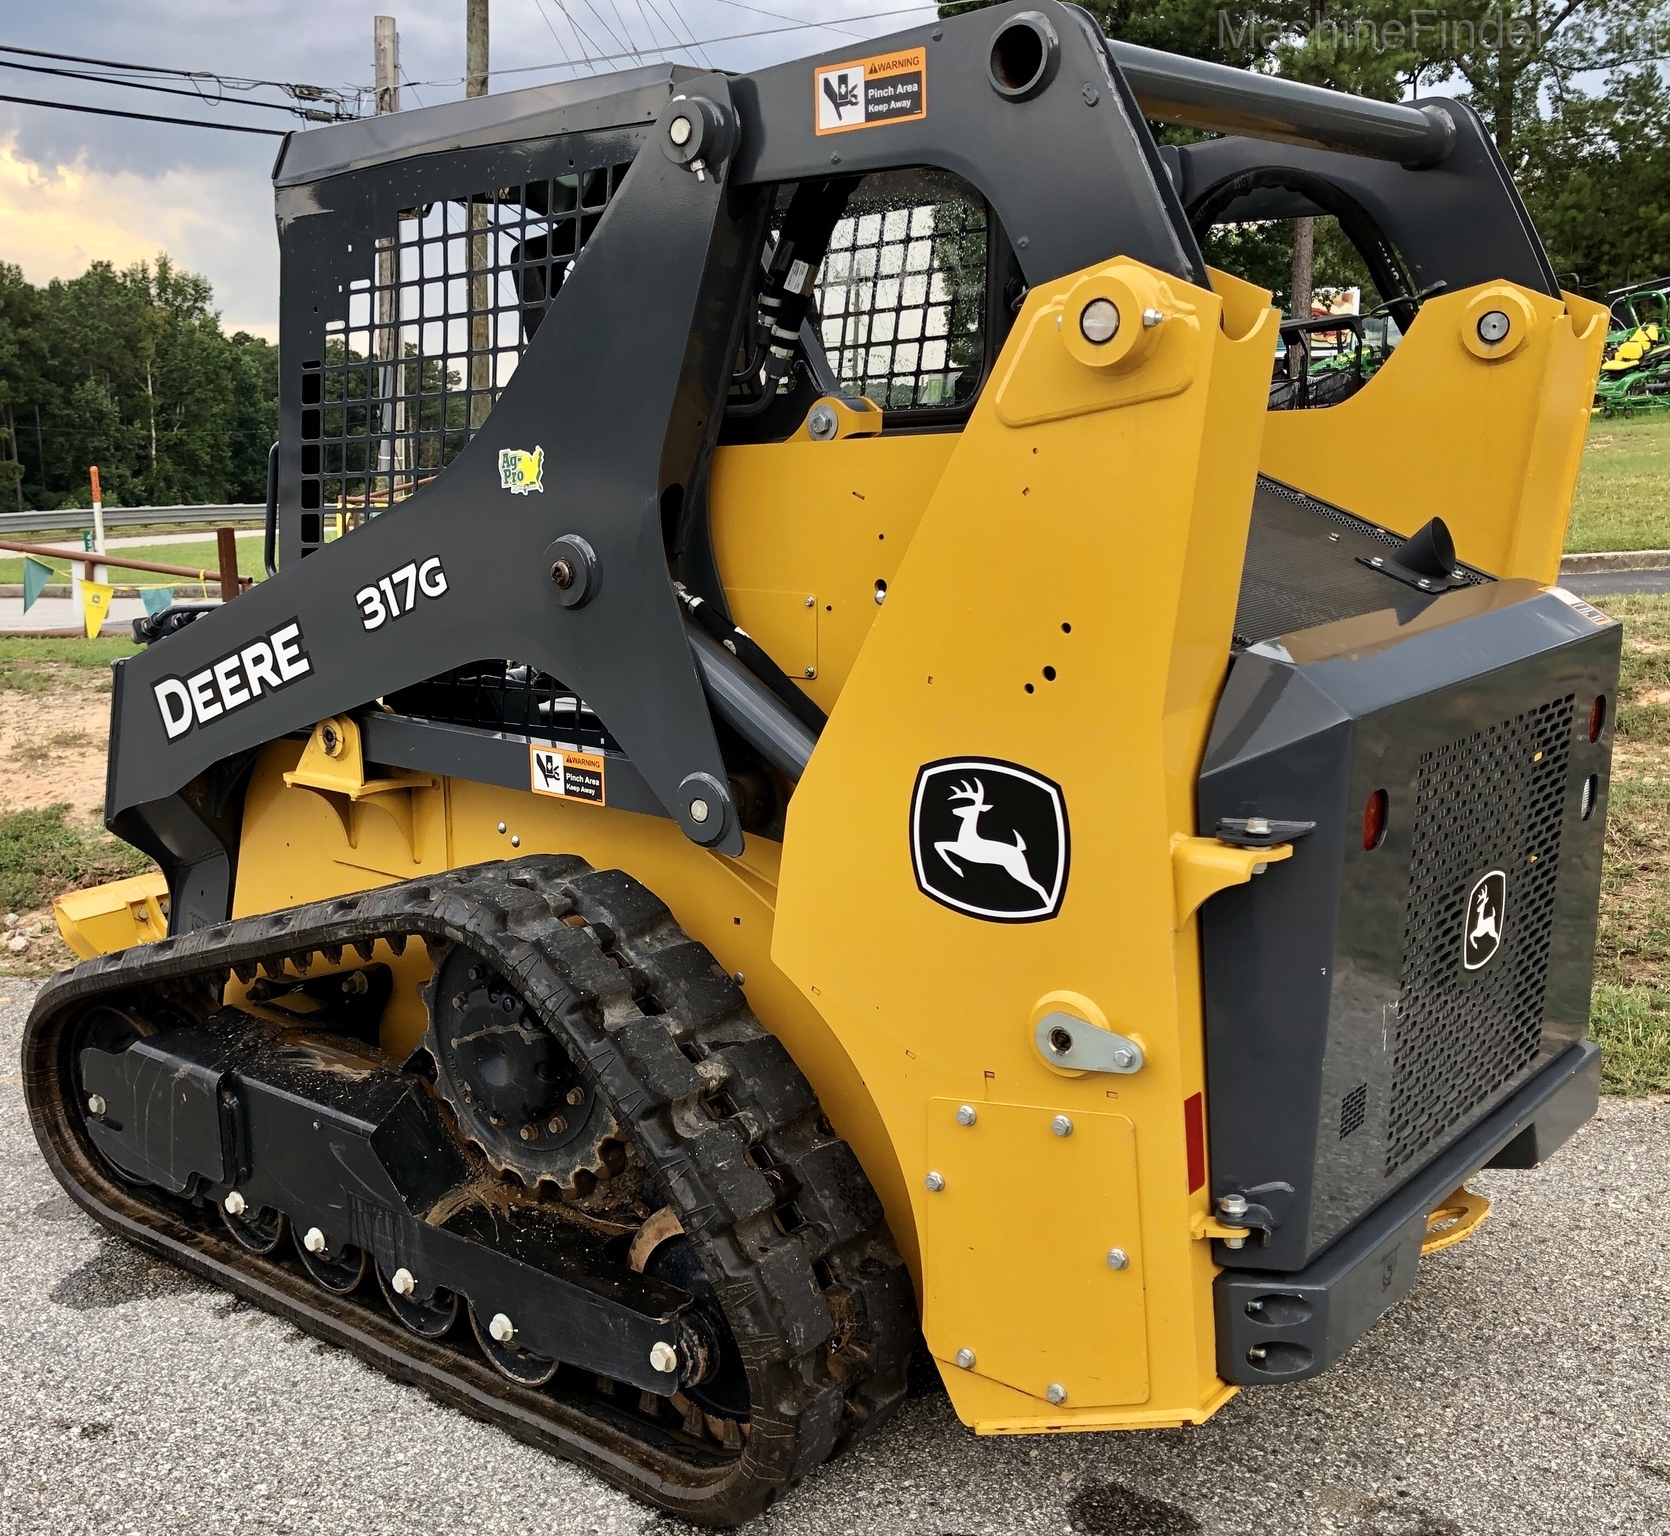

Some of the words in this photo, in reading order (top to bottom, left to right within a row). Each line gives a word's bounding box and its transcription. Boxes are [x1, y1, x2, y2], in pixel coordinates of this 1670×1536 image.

[877, 56, 920, 72] WARNING
[868, 87, 894, 99] Pinch
[896, 83, 918, 94] Area
[868, 103, 888, 113] Keep
[889, 99, 911, 110] Away
[502, 453, 521, 470] Ag-
[503, 469, 524, 484] Pro
[356, 557, 449, 631] 317G
[154, 622, 311, 739] DEERE
[572, 757, 600, 768] WARNING
[566, 772, 584, 783] Pinch
[585, 776, 600, 786] Area
[566, 783, 580, 793] Keep
[581, 786, 596, 796] Away
